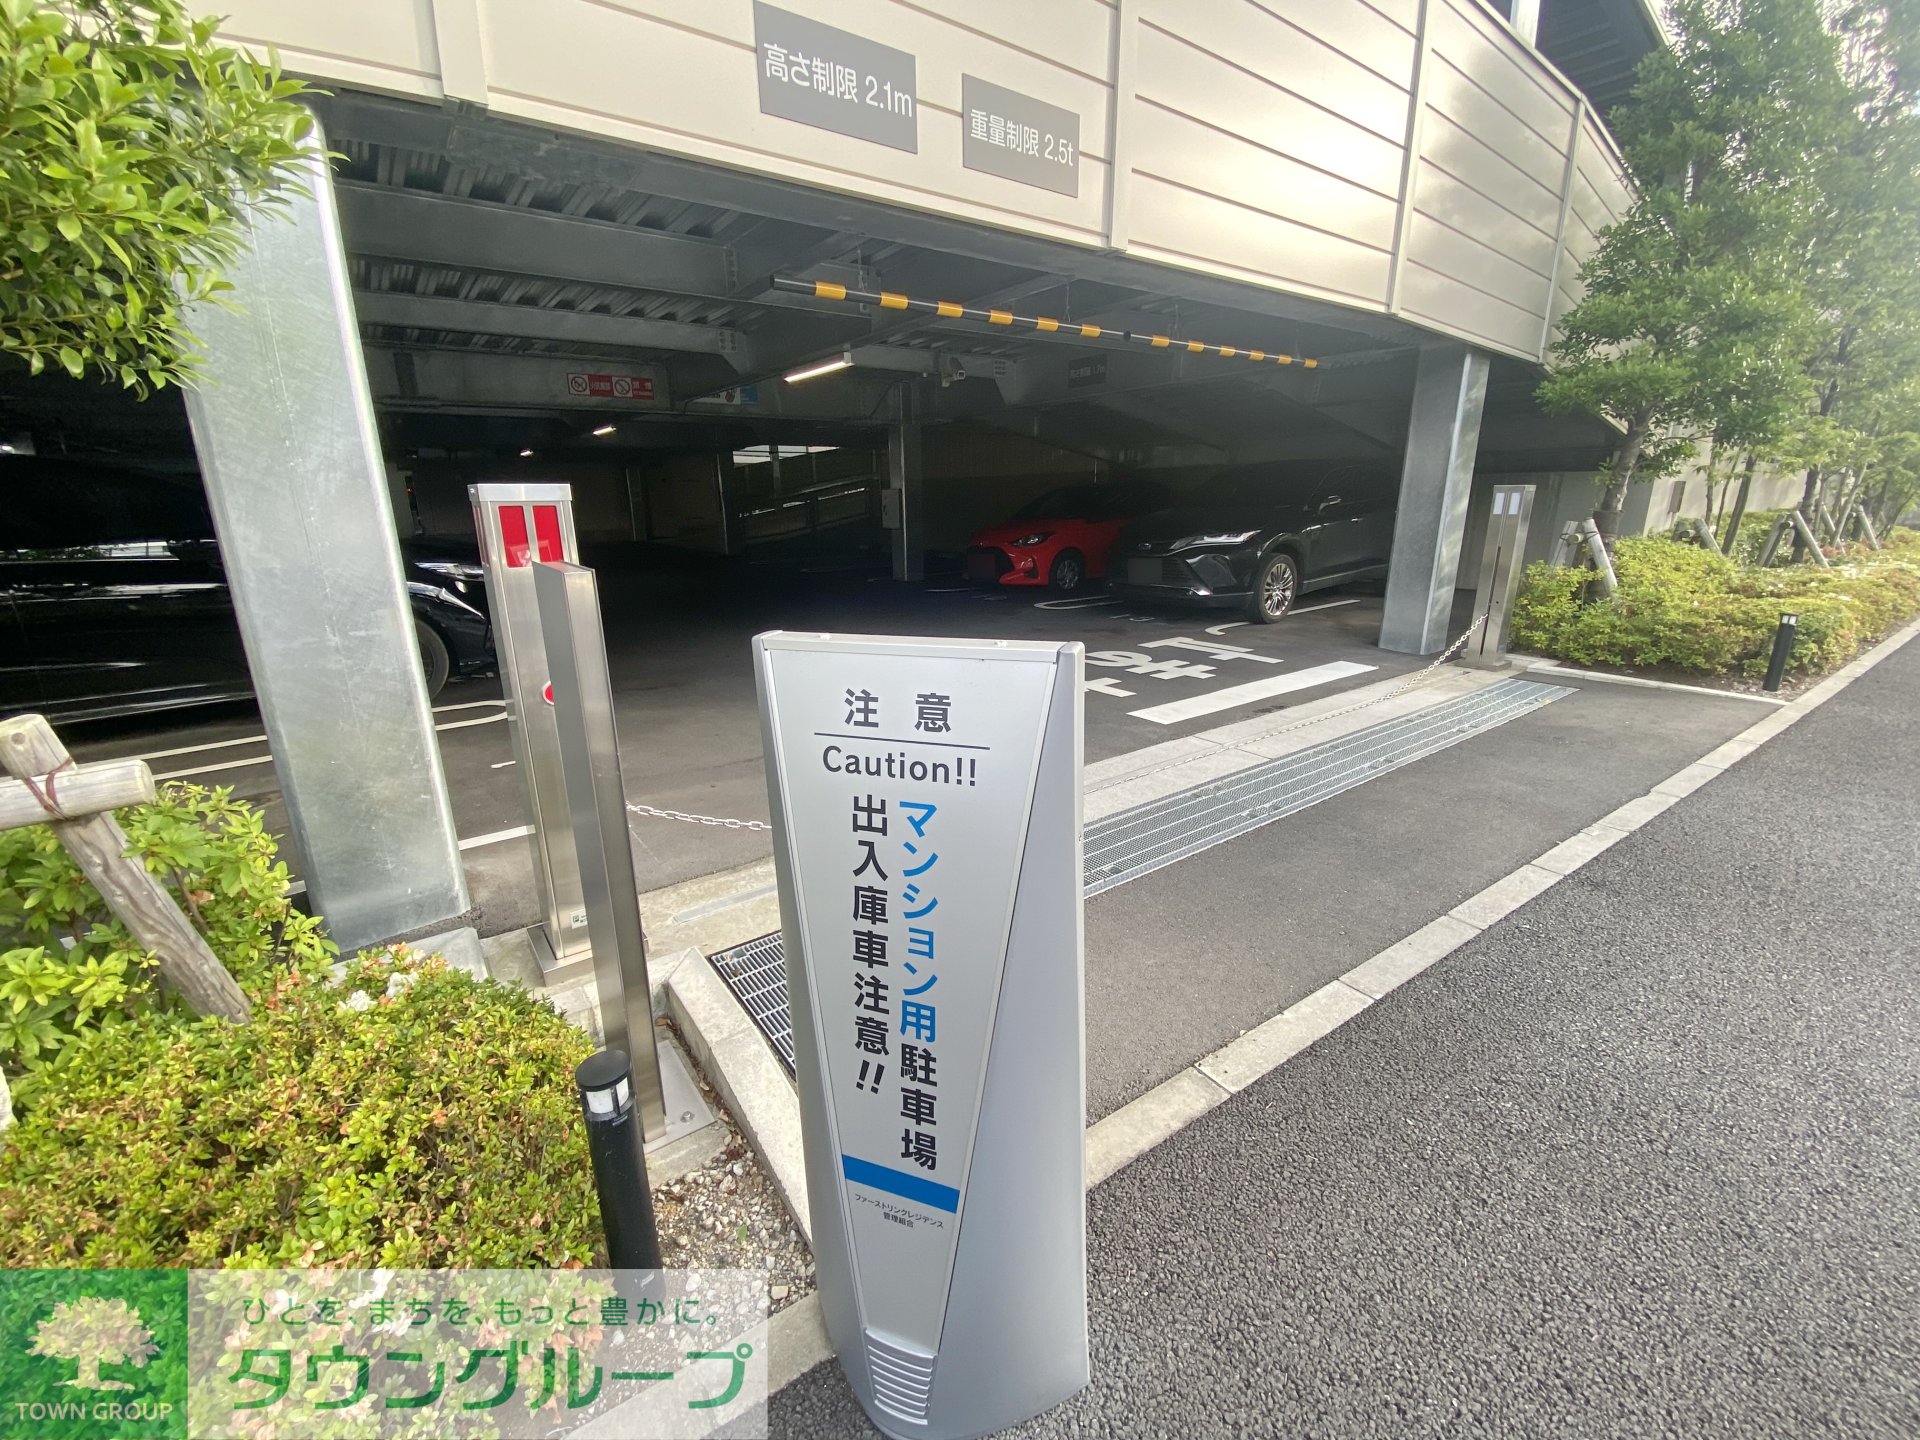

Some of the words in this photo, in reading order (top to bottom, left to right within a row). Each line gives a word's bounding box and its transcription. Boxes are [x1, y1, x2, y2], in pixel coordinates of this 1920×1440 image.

[763, 43, 858, 103] 高さ制限
[865, 75, 913, 118] 2.1m
[970, 108, 1039, 158] 重量制限
[1044, 134, 1074, 167] 2.5t
[823, 745, 976, 787] Caution!!
[899, 800, 939, 1171] マンション用駐車場
[883, 1212, 914, 1228] 管理組合
